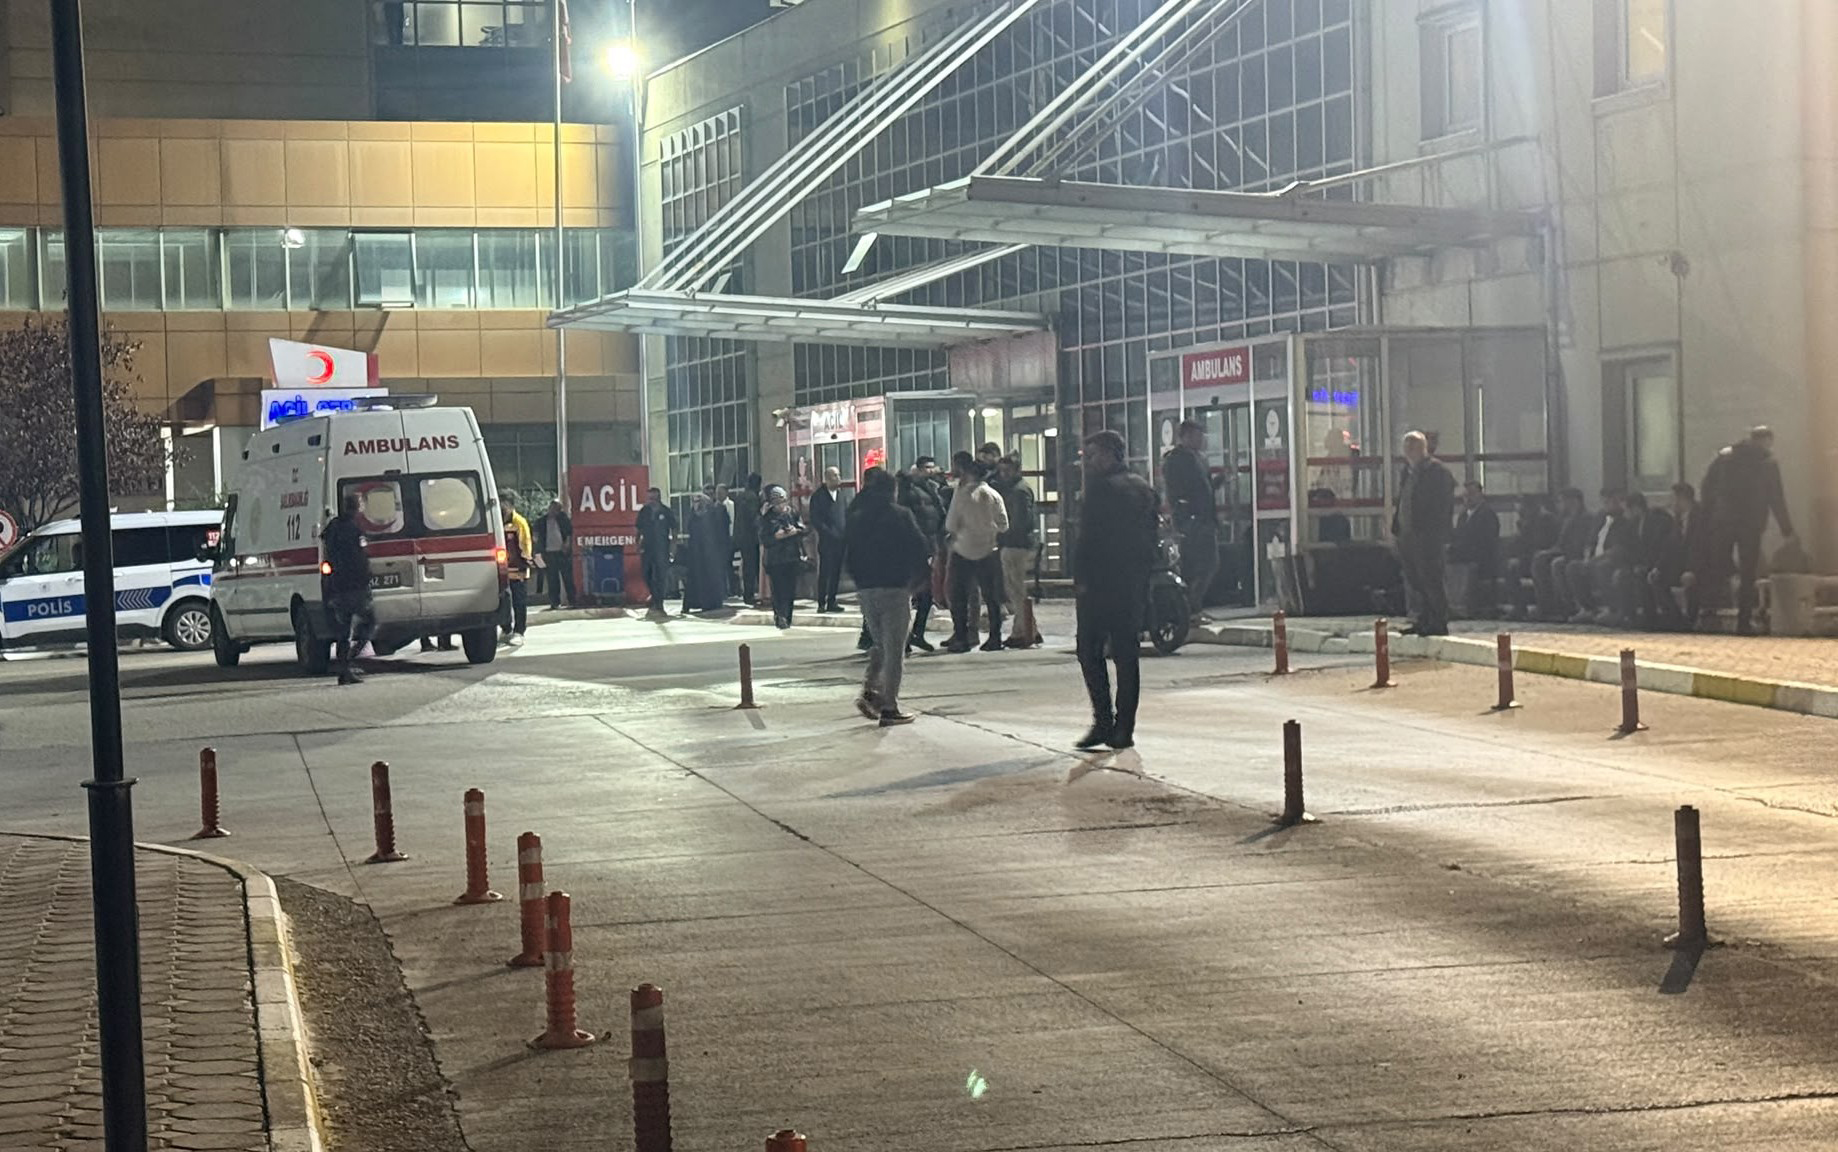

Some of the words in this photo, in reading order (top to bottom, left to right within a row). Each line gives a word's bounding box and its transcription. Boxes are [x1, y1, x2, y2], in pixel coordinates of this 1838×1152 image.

[1191, 355, 1242, 382] AMBULANS
[343, 434, 460, 456] AMBULANS
[579, 478, 644, 512] ACİL
[286, 513, 301, 541] 112
[577, 536, 636, 546] EMERGEN
[27, 600, 73, 617] POLİS
